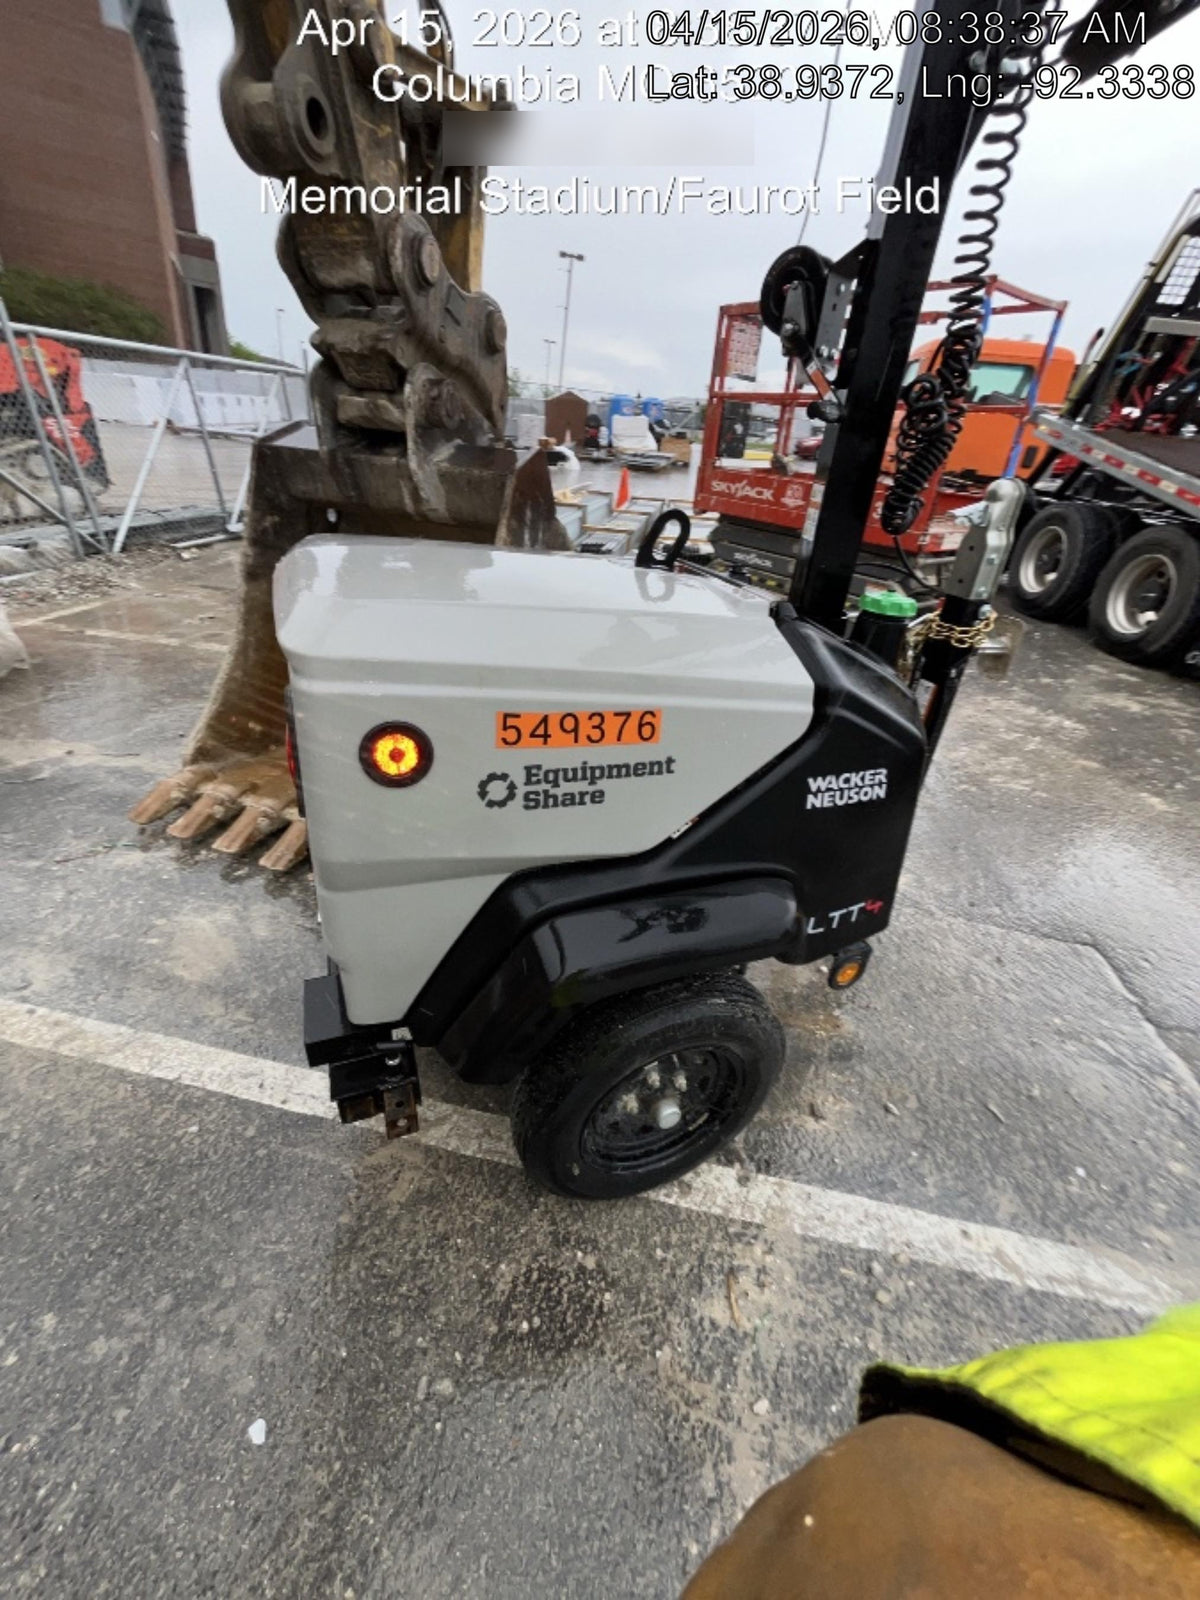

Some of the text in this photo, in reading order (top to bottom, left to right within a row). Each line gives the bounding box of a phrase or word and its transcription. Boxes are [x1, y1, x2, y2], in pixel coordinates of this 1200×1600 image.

[711, 480, 774, 501] SKYJACK
[501, 710, 657, 746] 549376
[523, 756, 676, 788] Equipment
[807, 768, 888, 792] WACKER
[522, 789, 606, 810] Share
[806, 784, 887, 810] NEUSON
